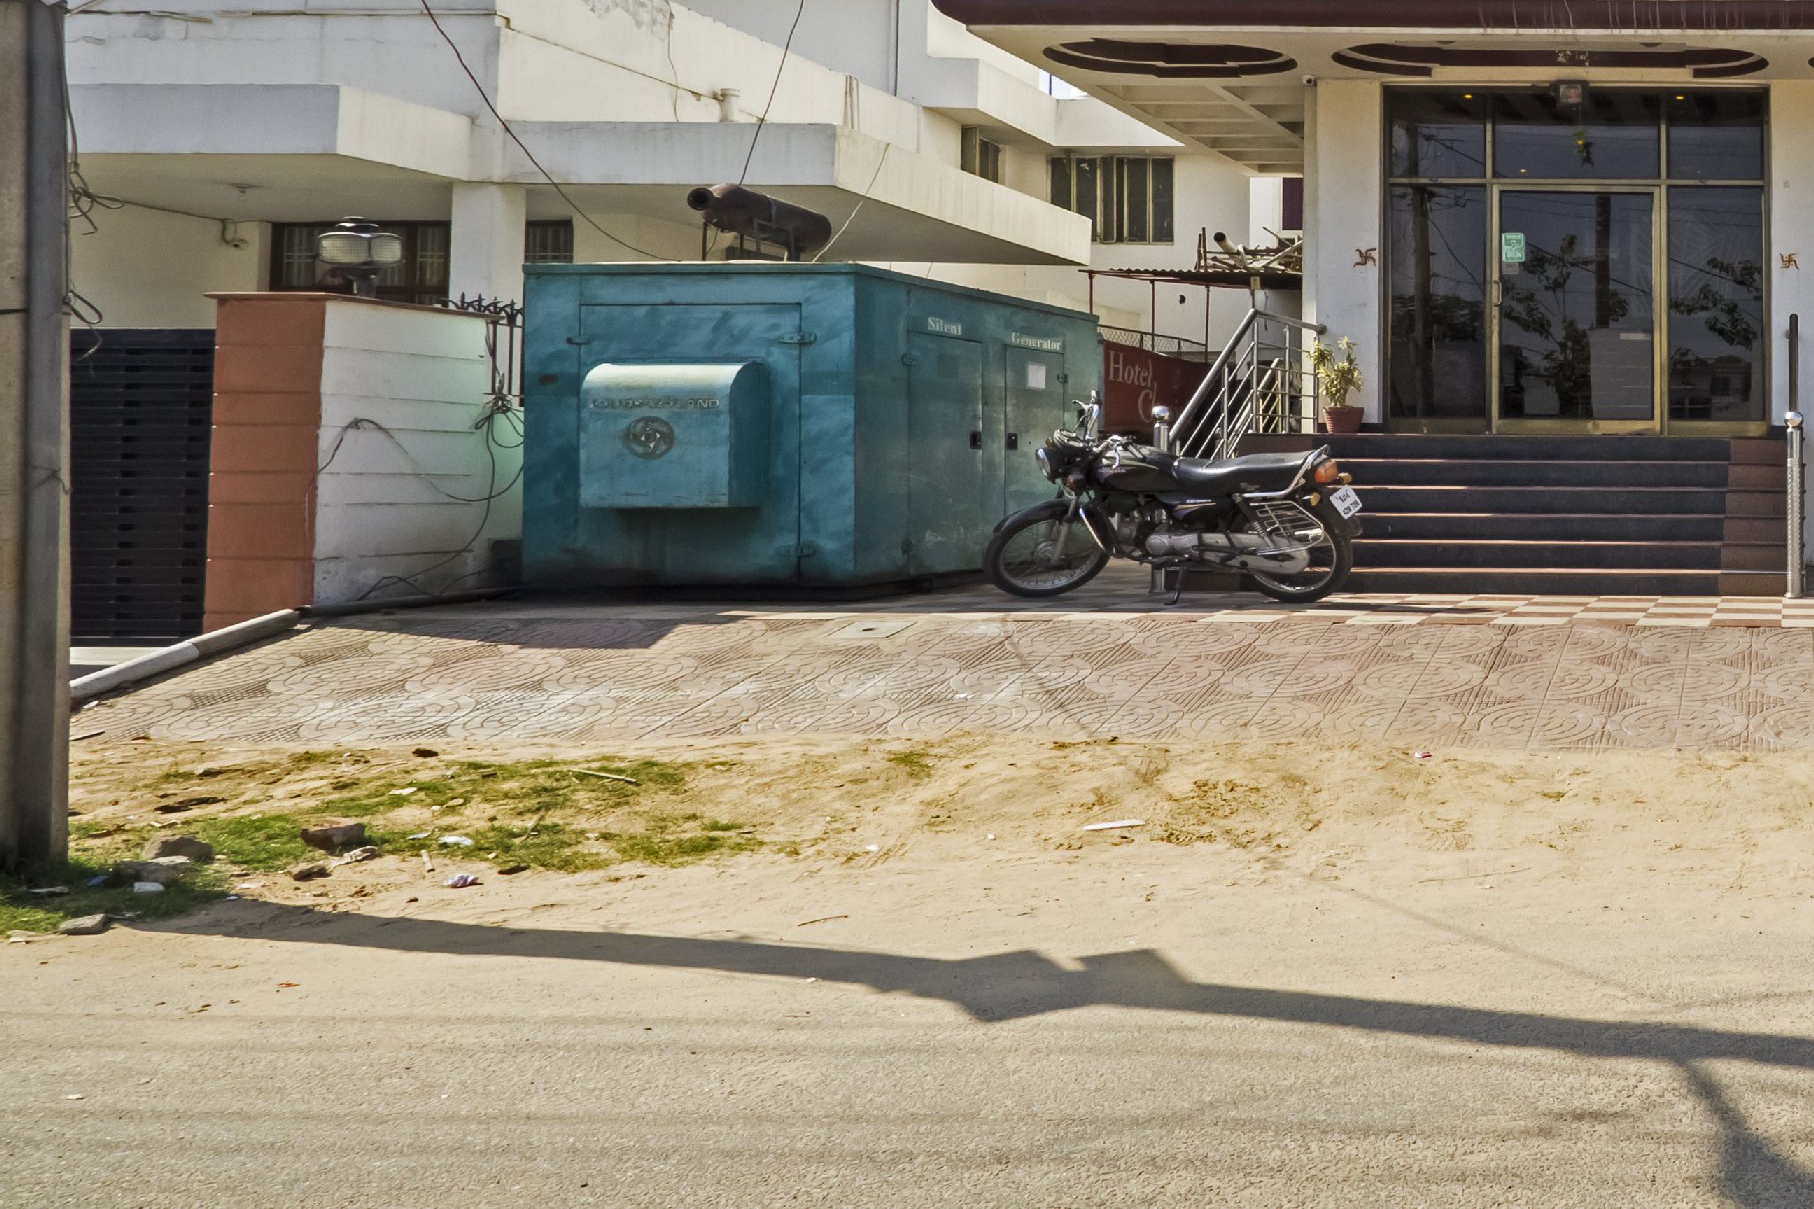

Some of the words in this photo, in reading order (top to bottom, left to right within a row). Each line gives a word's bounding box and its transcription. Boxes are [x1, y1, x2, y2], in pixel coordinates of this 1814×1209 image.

[928, 316, 962, 336] Silent
[1011, 331, 1062, 351] Generator
[1109, 350, 1153, 388] Hotel
